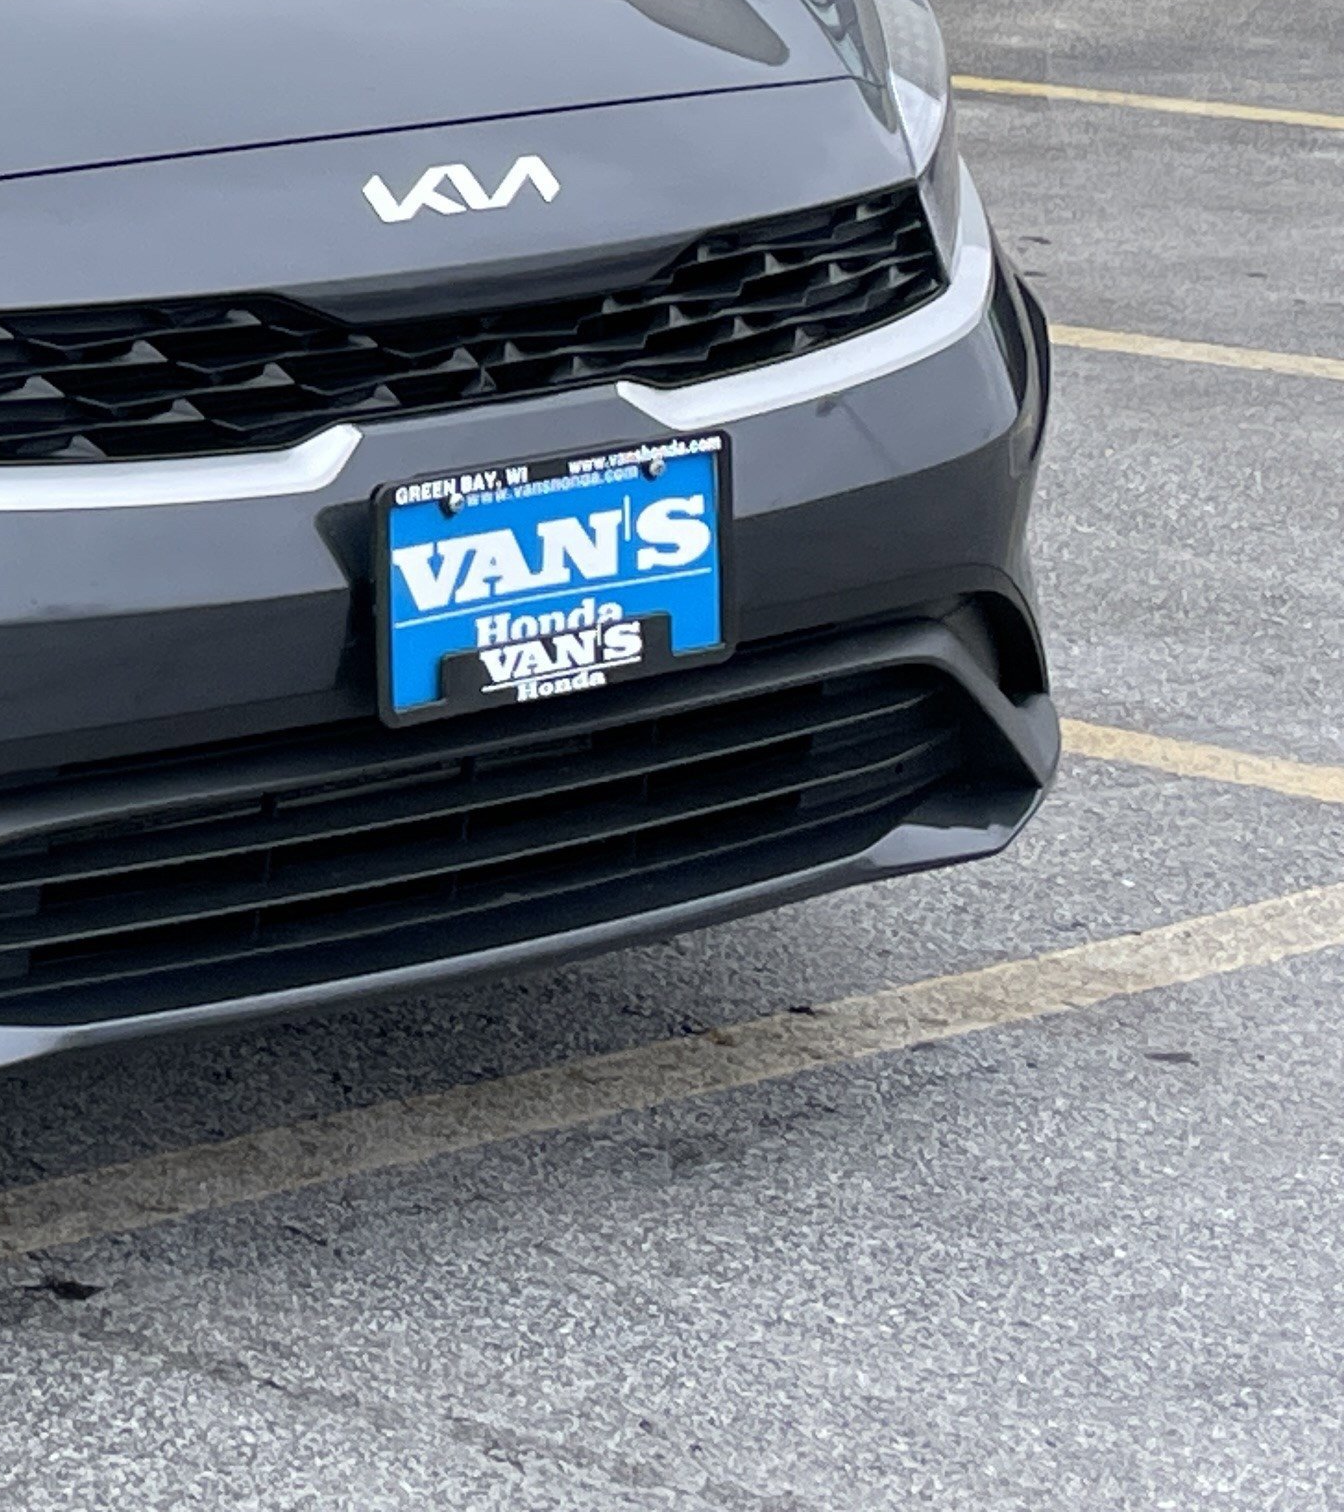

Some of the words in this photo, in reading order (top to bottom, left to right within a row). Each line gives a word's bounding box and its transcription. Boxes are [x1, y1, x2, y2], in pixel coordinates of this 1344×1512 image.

[568, 436, 722, 473] www.vanshonda.com
[395, 478, 456, 506] GREEN
[461, 471, 503, 496] BAY,
[505, 466, 529, 485] WI
[391, 493, 711, 612] VAN'S
[476, 598, 623, 647] Honda
[479, 620, 643, 683] VAN'S
[517, 670, 606, 702] Honda
